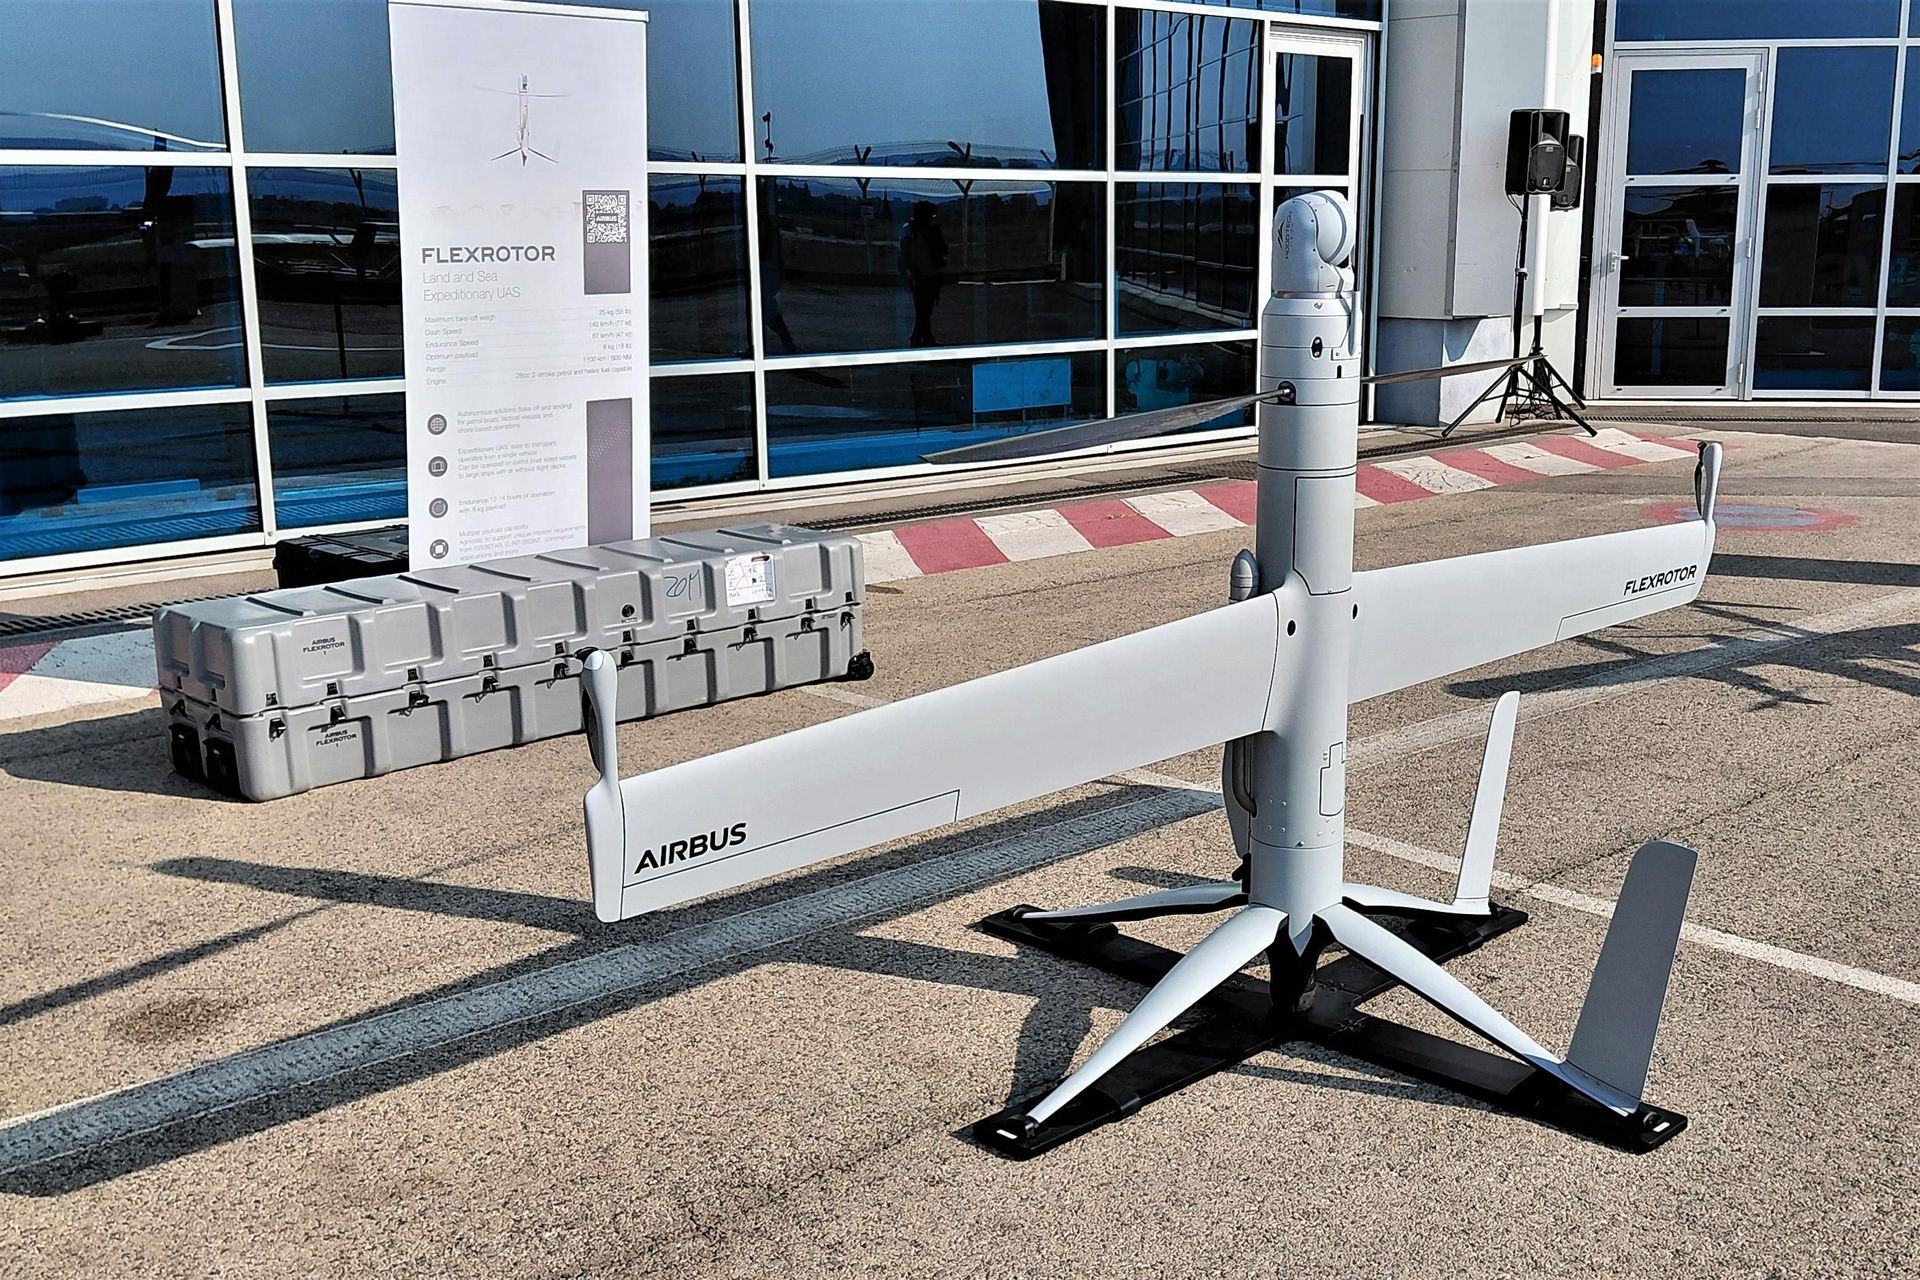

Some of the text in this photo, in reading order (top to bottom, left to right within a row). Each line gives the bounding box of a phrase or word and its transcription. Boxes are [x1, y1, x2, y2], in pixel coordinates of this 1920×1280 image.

[421, 245, 556, 264] FLEXROTOR
[422, 270, 498, 284] Land and Sea
[423, 286, 521, 303] Expeditionary UAS
[442, 328, 462, 336] Speed
[459, 339, 479, 347] Speed
[425, 352, 479, 361] Optimum payload
[426, 366, 446, 374] Range
[426, 378, 447, 386] Engine
[458, 498, 488, 506] Endurance
[506, 493, 522, 501] hours
[1623, 564, 1697, 596] FLEXROTOR
[303, 641, 345, 653] FLEXROTOR
[312, 637, 335, 645] AIRBUS
[316, 733, 357, 746] FLEXROTOR
[325, 729, 348, 739] AIRBUS
[633, 822, 747, 875] AIRBUS
